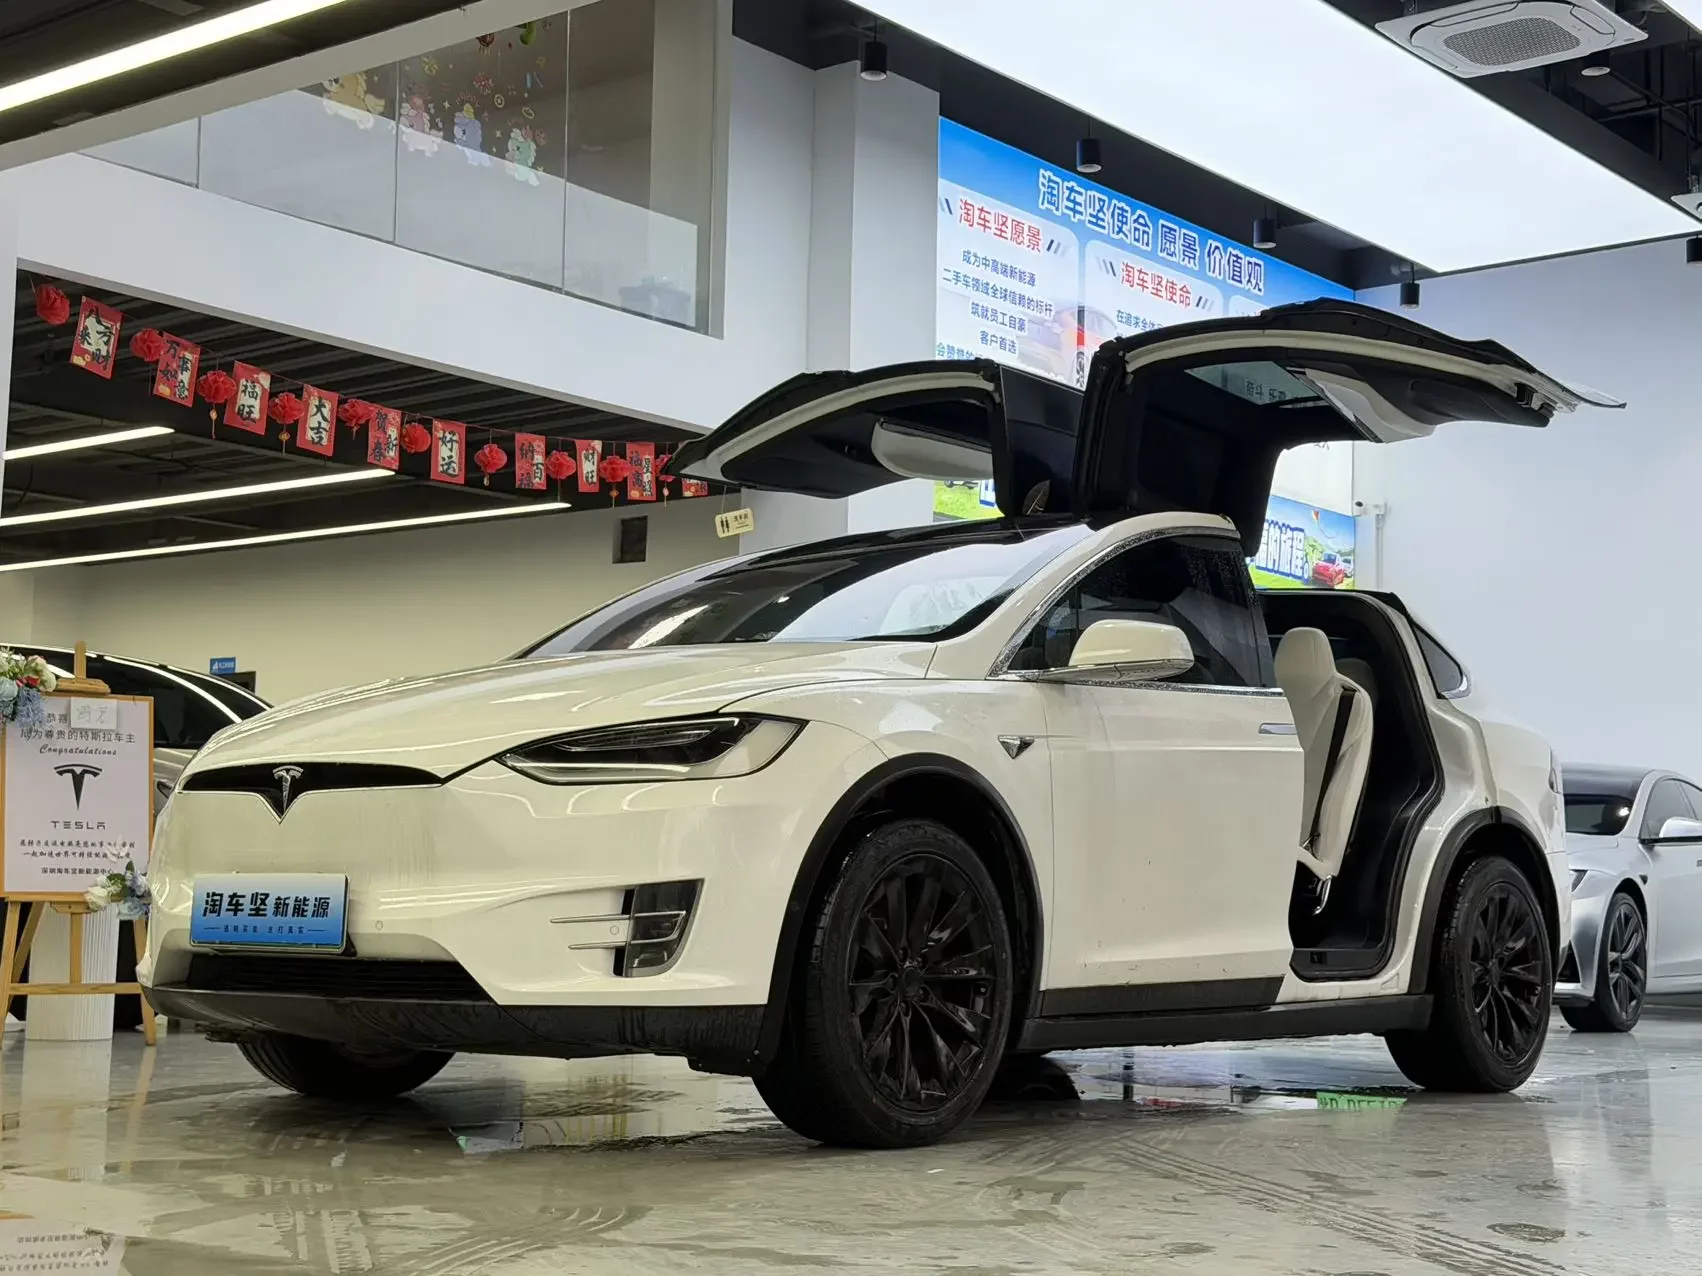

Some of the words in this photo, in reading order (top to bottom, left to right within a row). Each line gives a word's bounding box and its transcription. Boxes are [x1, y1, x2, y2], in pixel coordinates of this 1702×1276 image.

[959, 199, 1042, 253] 淘车坚愿景
[1038, 170, 1152, 251] 淘车坚使命
[1159, 222, 1200, 270] 愿景
[1206, 240, 1265, 296] 价值观
[961, 250, 1036, 288] 成为中高端新能源
[1121, 261, 1192, 308] 淘车坚使命
[942, 268, 1054, 317] 二手车领域全球信赖的标杆
[970, 301, 1027, 333] 筑就员工自豪
[1116, 309, 1165, 332] 在追求全体
[979, 330, 1018, 355] 客户首选
[236, 379, 261, 425] 福旺
[309, 396, 331, 448] 大吉
[438, 429, 460, 478] 好运
[39, 743, 117, 756] Congratulations
[50, 820, 106, 830] TESLA
[203, 891, 331, 919] 淘车坚新能源
